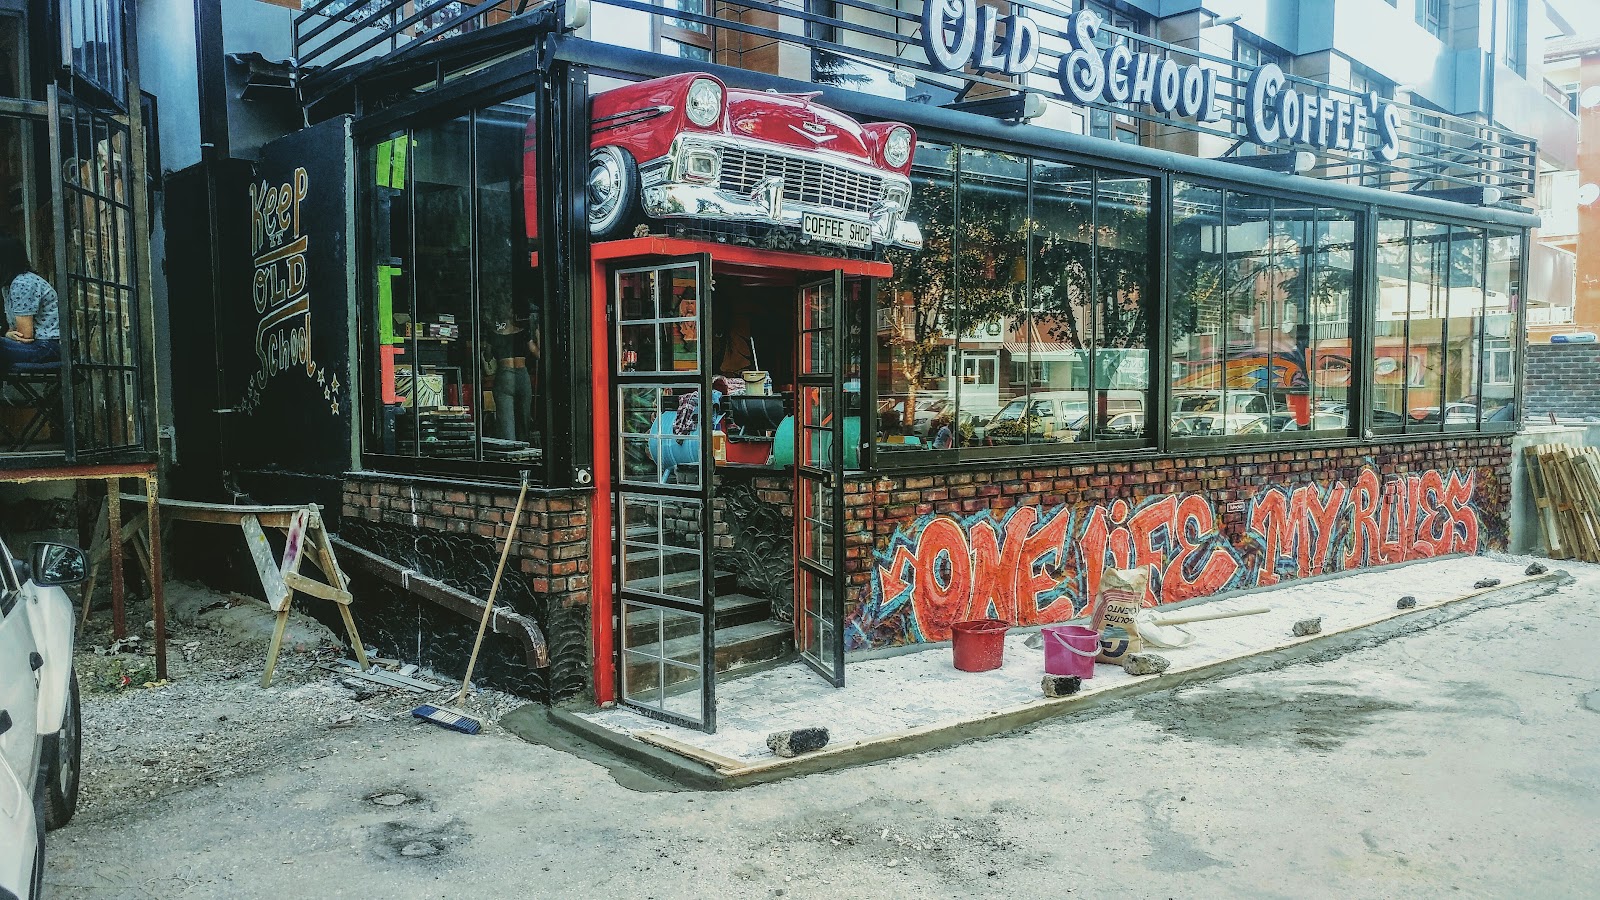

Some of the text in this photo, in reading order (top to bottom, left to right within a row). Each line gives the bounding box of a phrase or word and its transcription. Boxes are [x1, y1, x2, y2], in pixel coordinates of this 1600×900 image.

[921, 0, 1402, 161] OLD SCHOOL COFFEE'S
[804, 215, 844, 238] COFFEE
[849, 223, 870, 242] SHOP
[253, 254, 307, 314] OLD
[908, 506, 1075, 641] ONE
[1251, 481, 1346, 587] MY
[1342, 467, 1479, 570] RULES
